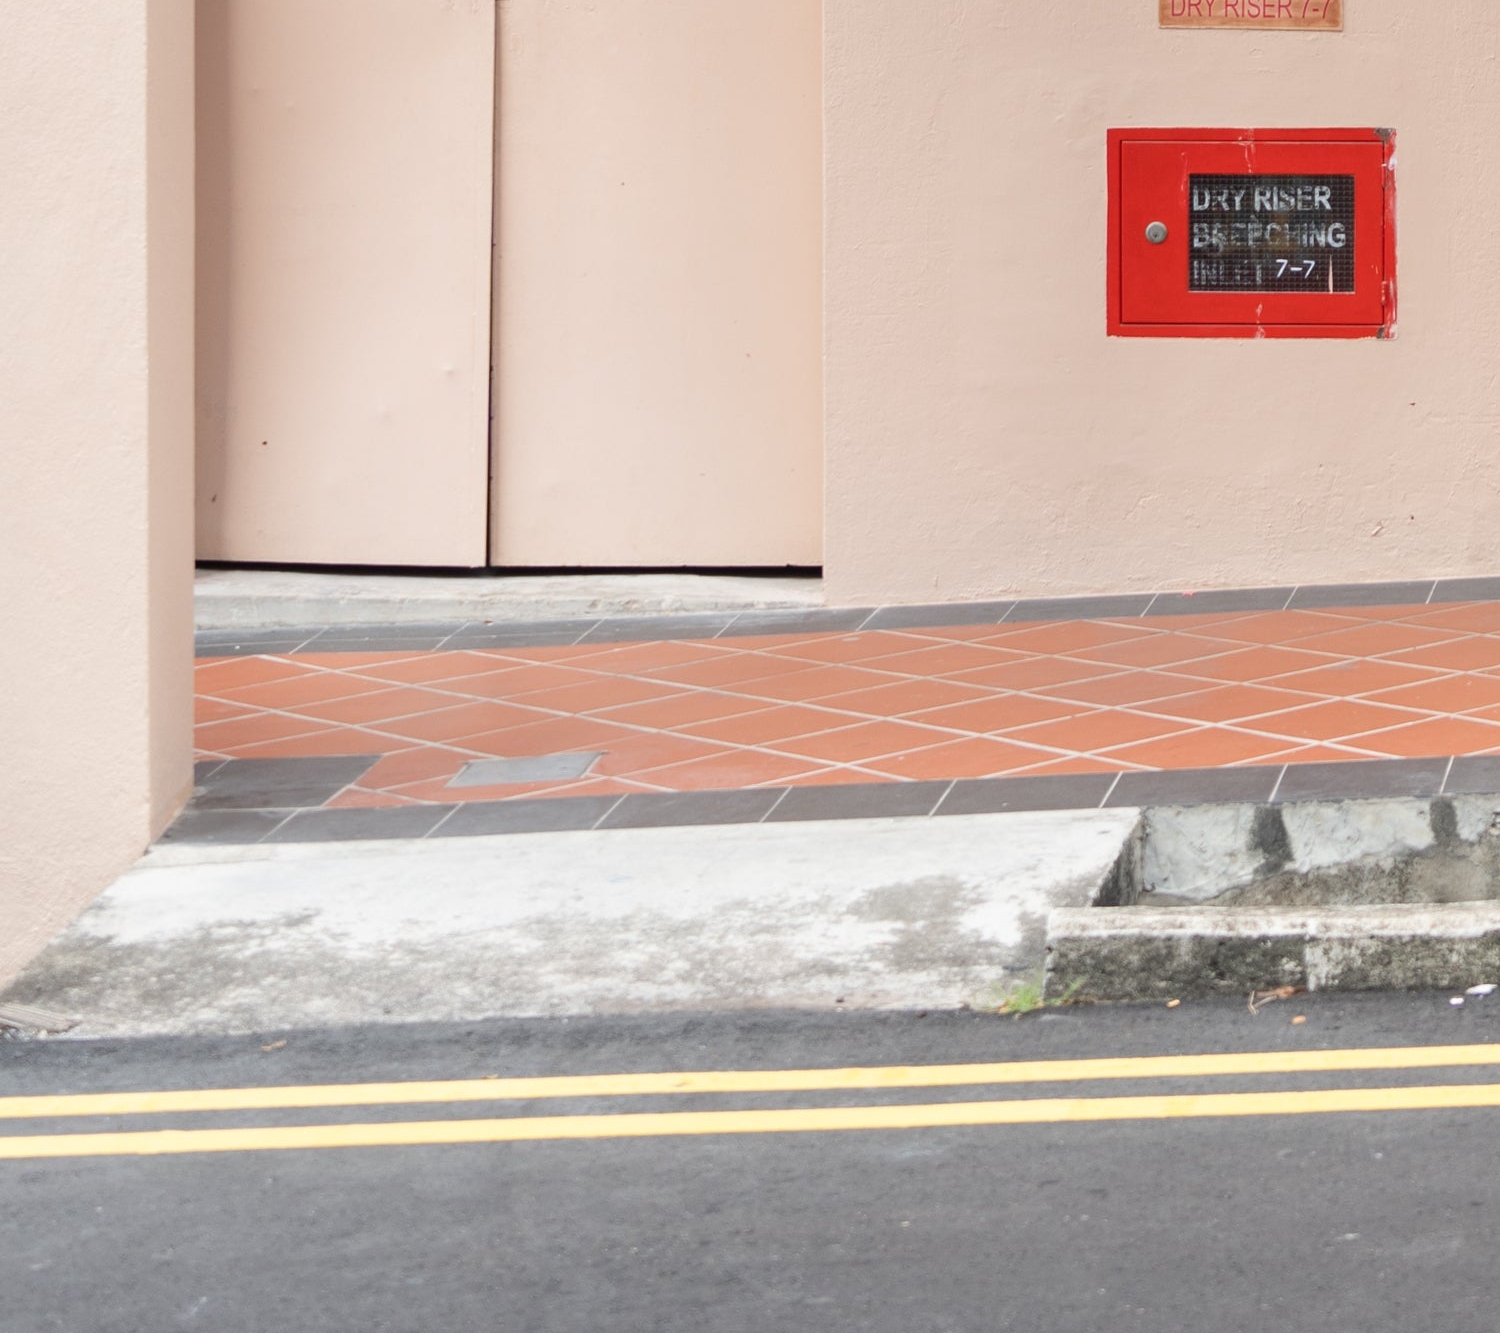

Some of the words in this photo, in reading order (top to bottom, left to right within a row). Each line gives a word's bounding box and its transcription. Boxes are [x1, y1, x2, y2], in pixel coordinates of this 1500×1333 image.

[1193, 186, 1246, 212] DRY
[1254, 185, 1332, 212] RISER
[1275, 259, 1316, 279] 7-7
